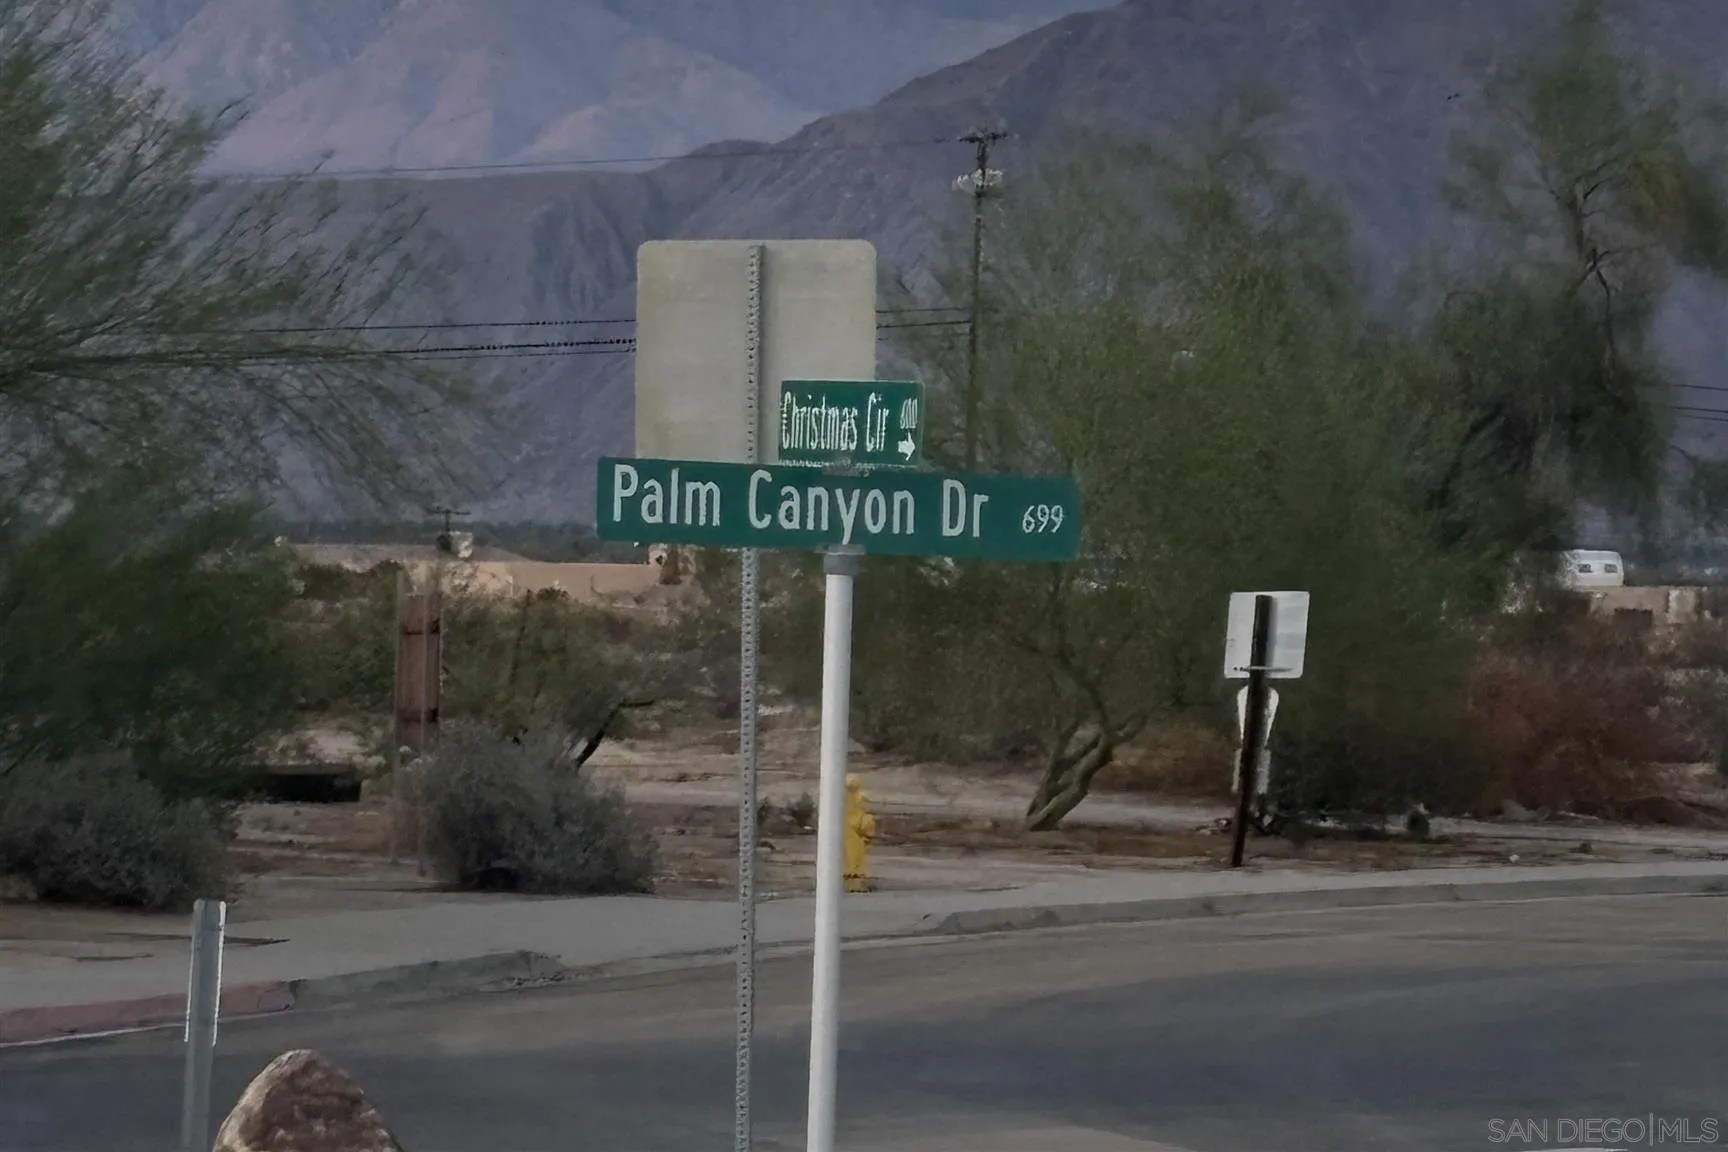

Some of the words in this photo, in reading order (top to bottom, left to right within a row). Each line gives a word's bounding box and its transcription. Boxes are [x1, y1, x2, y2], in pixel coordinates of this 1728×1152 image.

[781, 391, 858, 450] Christmas
[866, 392, 890, 452] Cir
[613, 464, 721, 527] Palm
[748, 469, 915, 545] Canyon
[942, 479, 989, 538] Dr
[1022, 504, 1064, 534] 699
